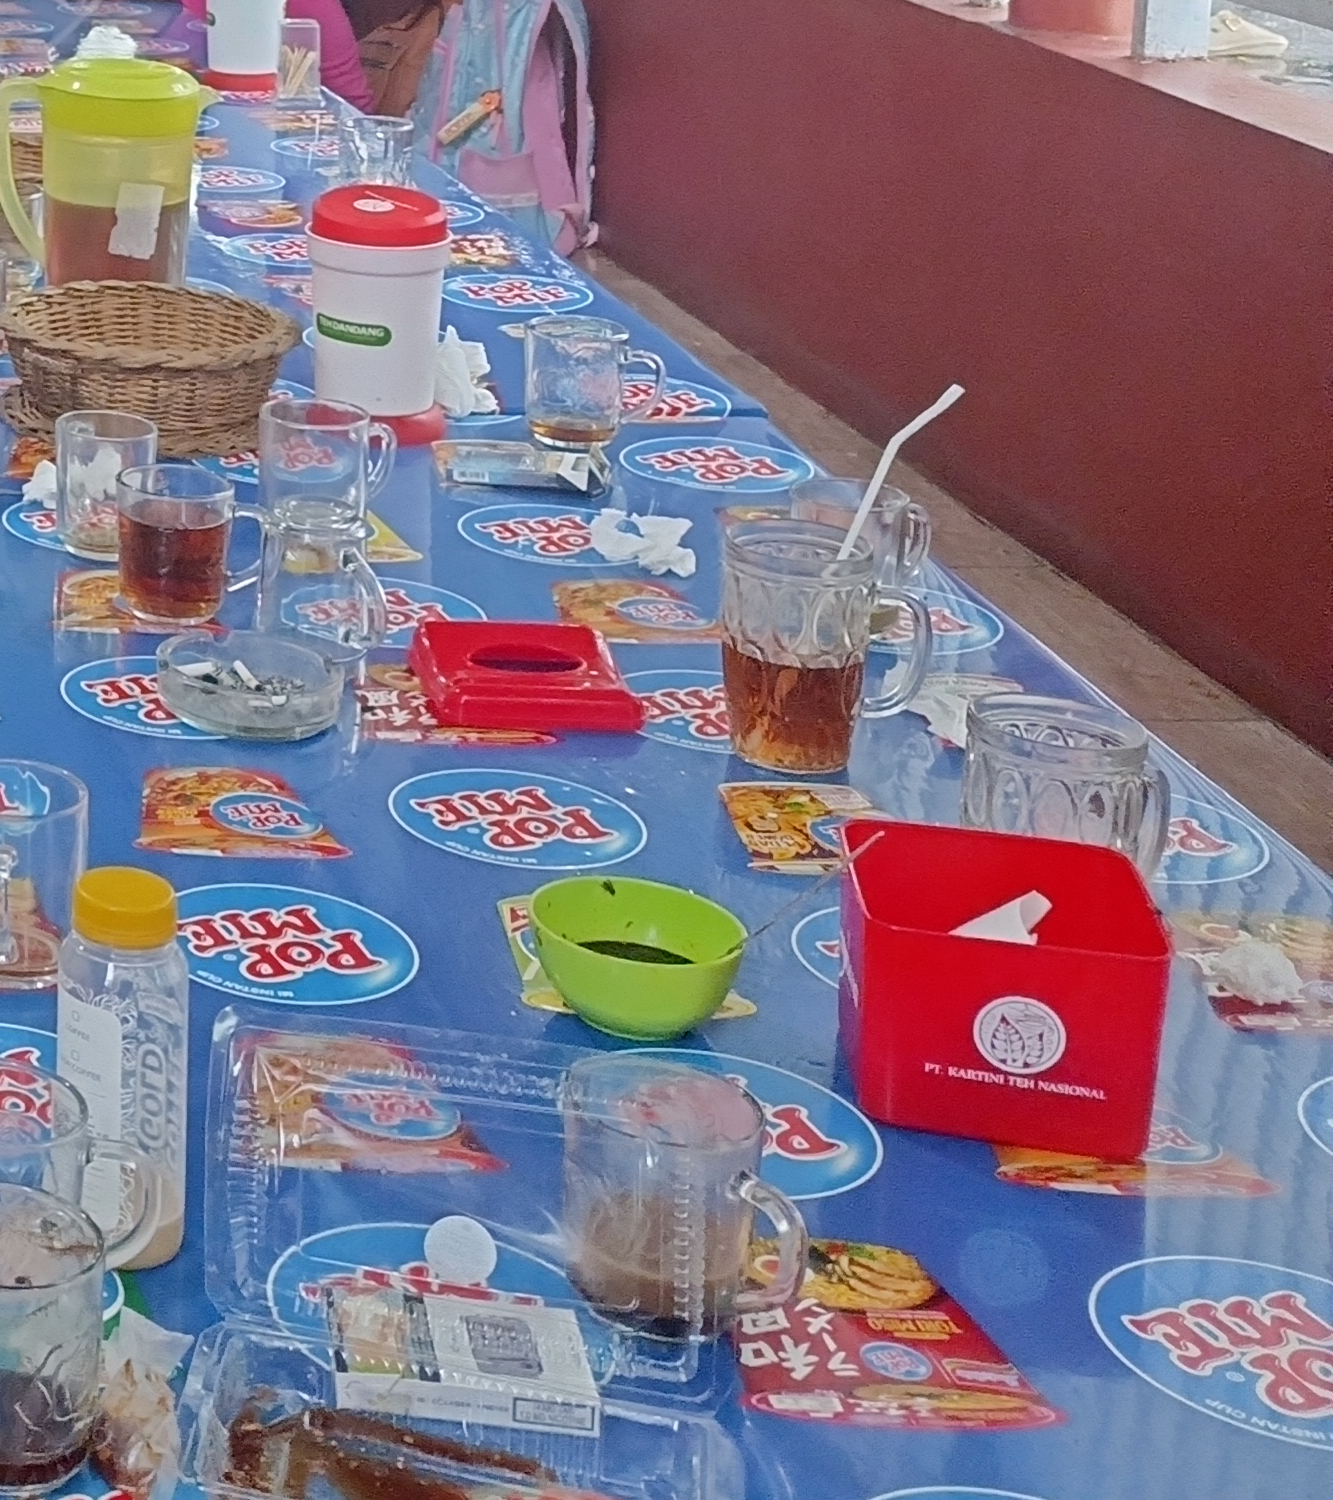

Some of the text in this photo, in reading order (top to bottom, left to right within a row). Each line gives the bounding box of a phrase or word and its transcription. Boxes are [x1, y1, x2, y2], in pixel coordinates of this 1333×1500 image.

[459, 279, 533, 301] POP
[494, 286, 581, 306] MIE
[331, 320, 385, 337] DANDANG
[634, 445, 746, 472] MIE
[694, 456, 794, 483] POP
[475, 514, 591, 543] MIE
[533, 534, 593, 557] OP
[220, 801, 285, 820] MIE
[249, 812, 306, 830] POP
[409, 786, 562, 831] MIE
[481, 806, 619, 852] POP
[177, 905, 333, 958] MIE
[239, 928, 389, 982] POP
[924, 1061, 1107, 1101] PT. KARTINI TEH NASIONAL
[1120, 1289, 1333, 1377] MIE
[1241, 1346, 1333, 1419] OP
